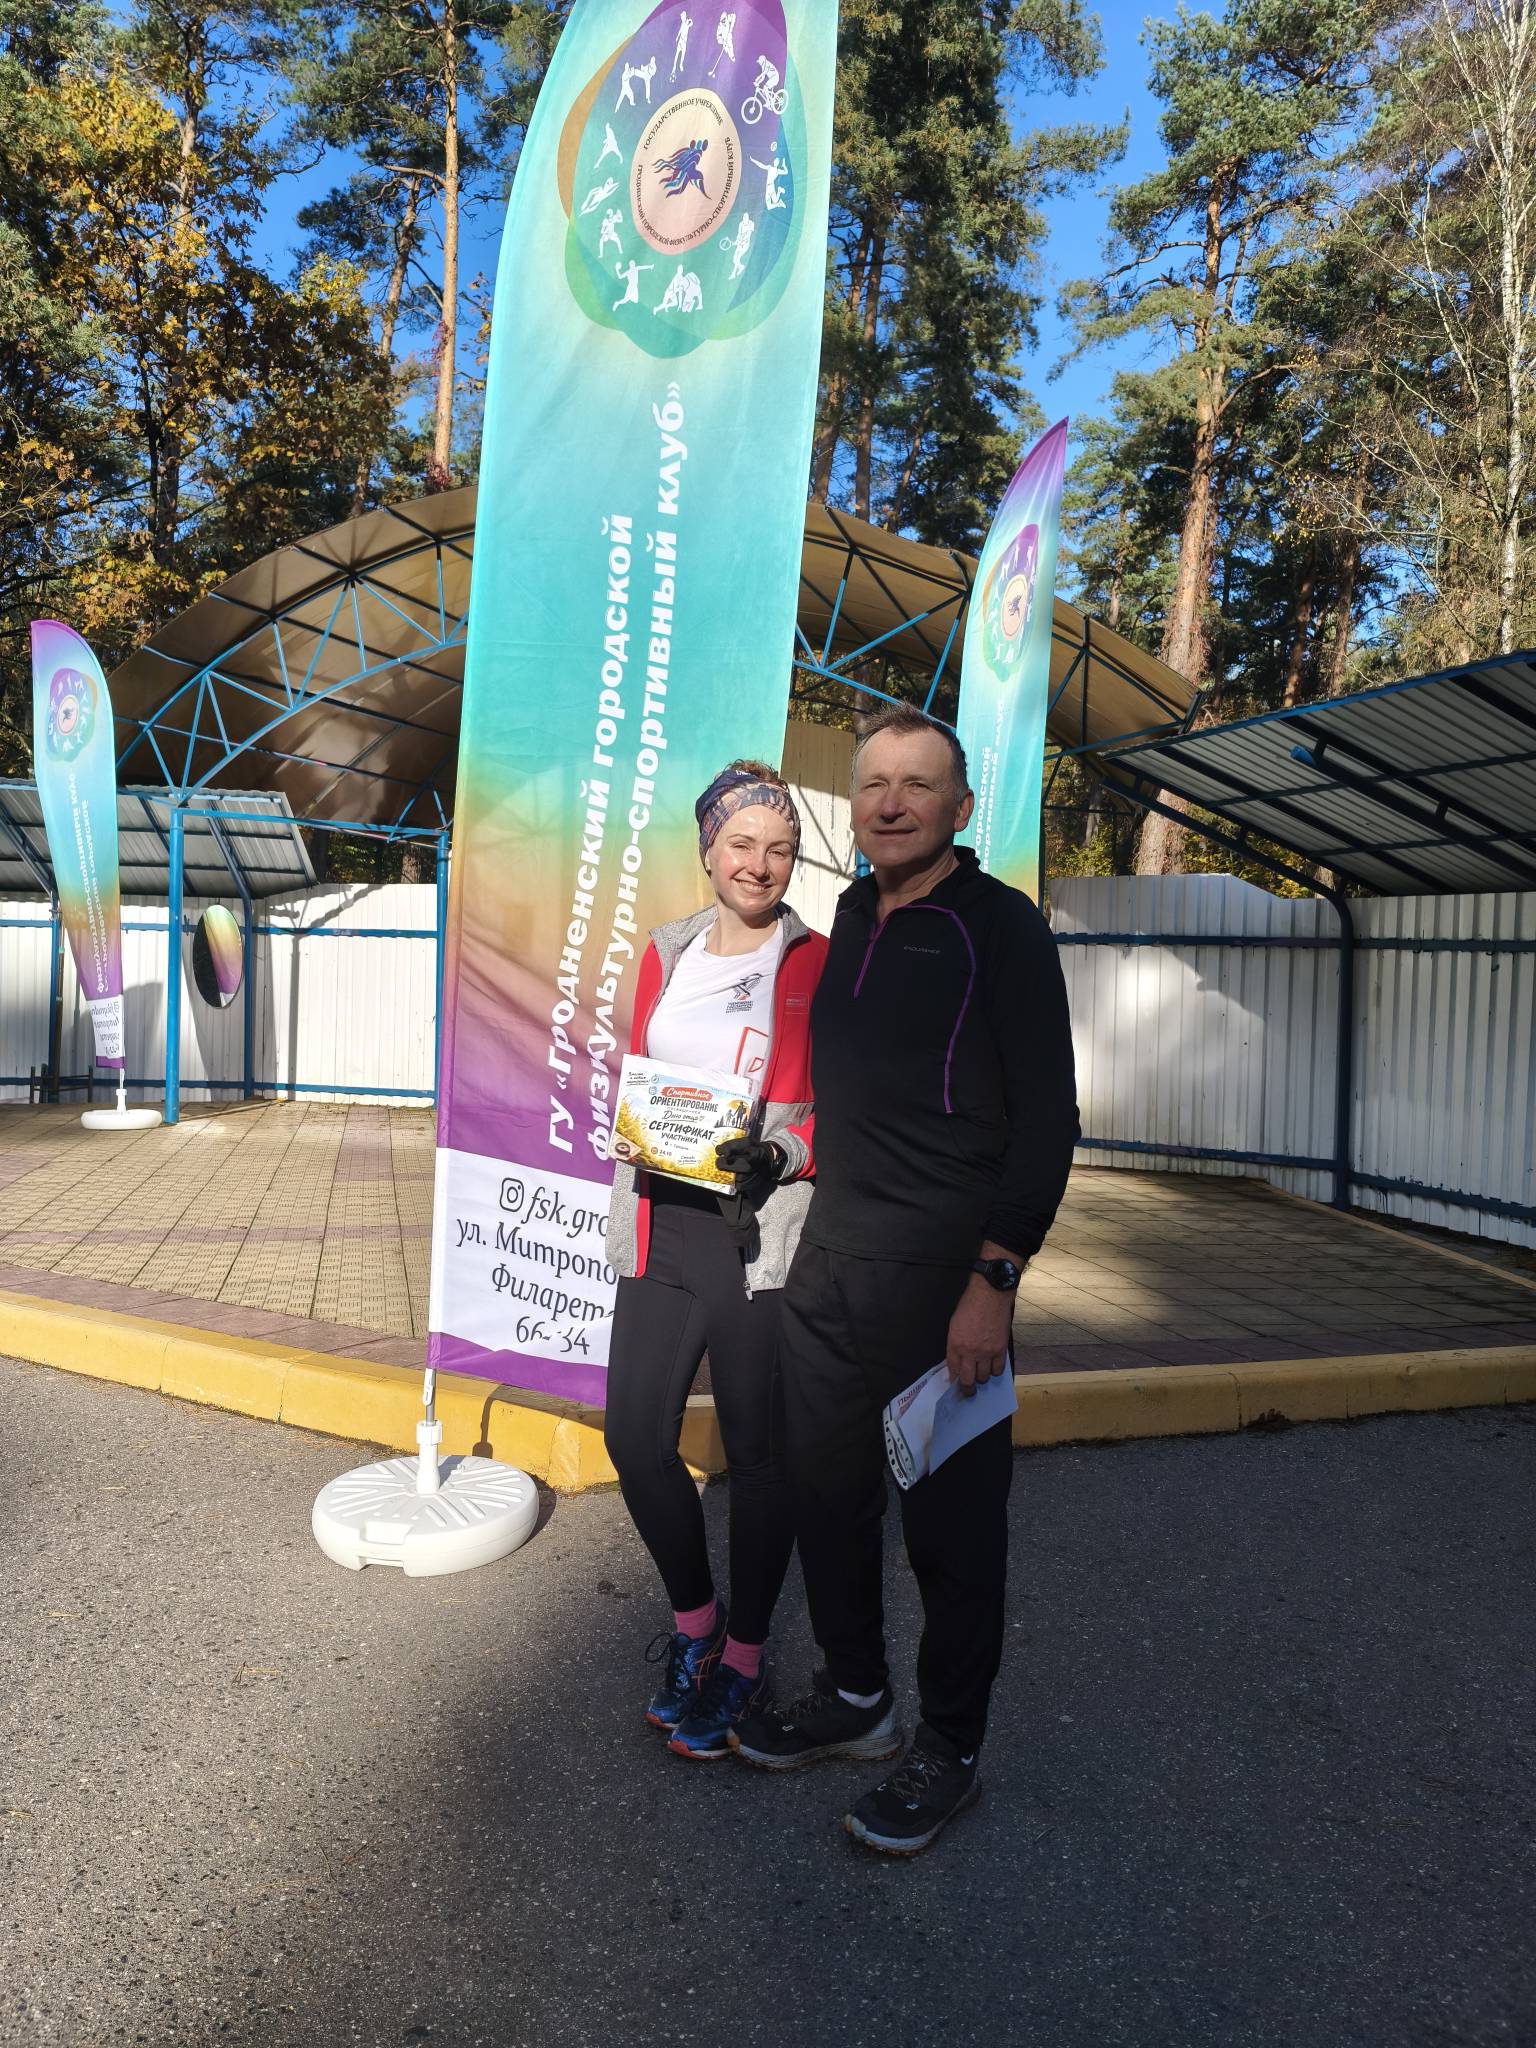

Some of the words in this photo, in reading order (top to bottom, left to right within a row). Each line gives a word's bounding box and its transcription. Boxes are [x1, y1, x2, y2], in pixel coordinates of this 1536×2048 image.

[643, 97, 694, 150] ГОСУДАРСТВЕННОЕ
[652, 381, 688, 516] клуб»
[548, 1094, 575, 1155] ГУ
[593, 513, 633, 768] городской
[650, 1095, 718, 1113] ОРИЕНТИРОВАНИЕ
[648, 1120, 715, 1140] СЕРТИФИКАТ
[661, 1132, 698, 1144] УЧАСТНИКА
[456, 1218, 487, 1248] ул.
[491, 1262, 615, 1321] Филарет
